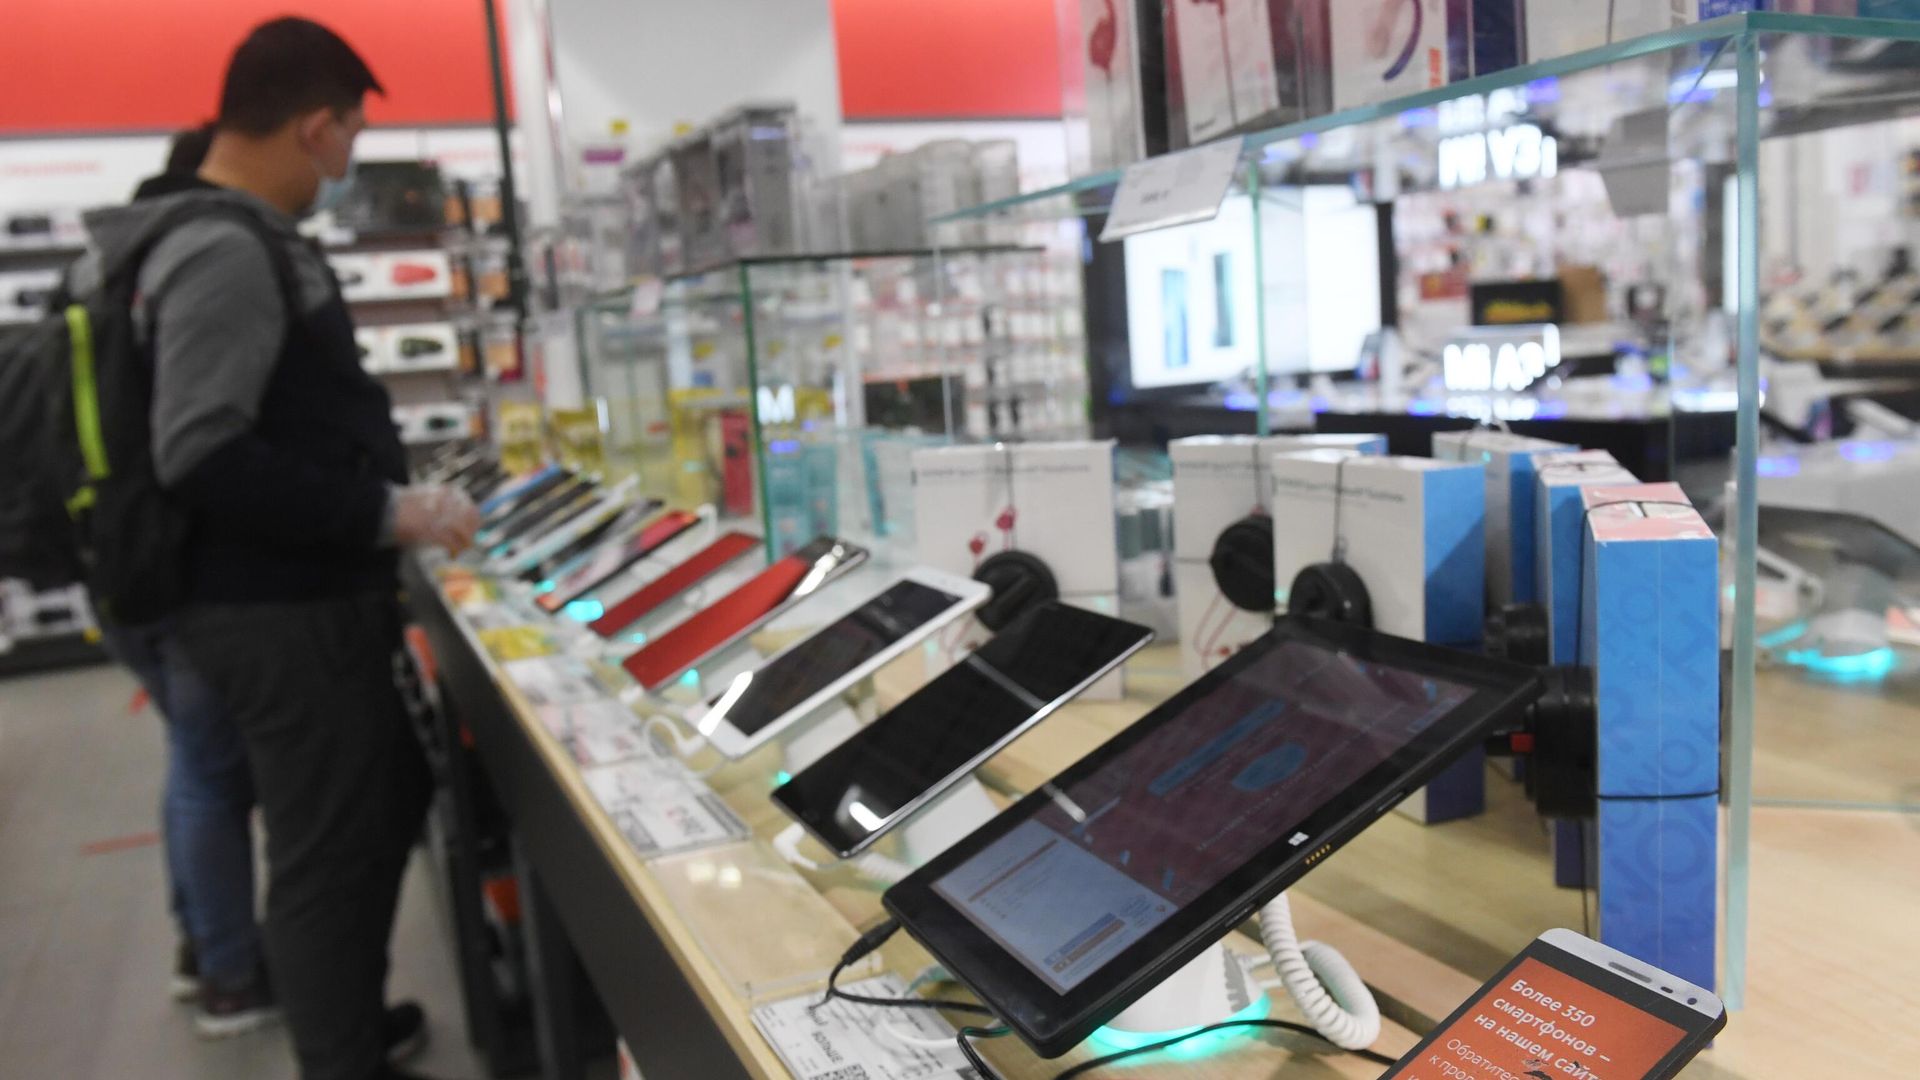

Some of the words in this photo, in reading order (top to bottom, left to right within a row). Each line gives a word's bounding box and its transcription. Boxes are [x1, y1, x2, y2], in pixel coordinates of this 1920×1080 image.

[1492, 997, 1597, 1056] смартфонов
[1510, 979, 1562, 1012] Более
[1560, 1004, 1596, 1027] 350
[1473, 1012, 1497, 1030] на
[1495, 1025, 1555, 1062] нашем
